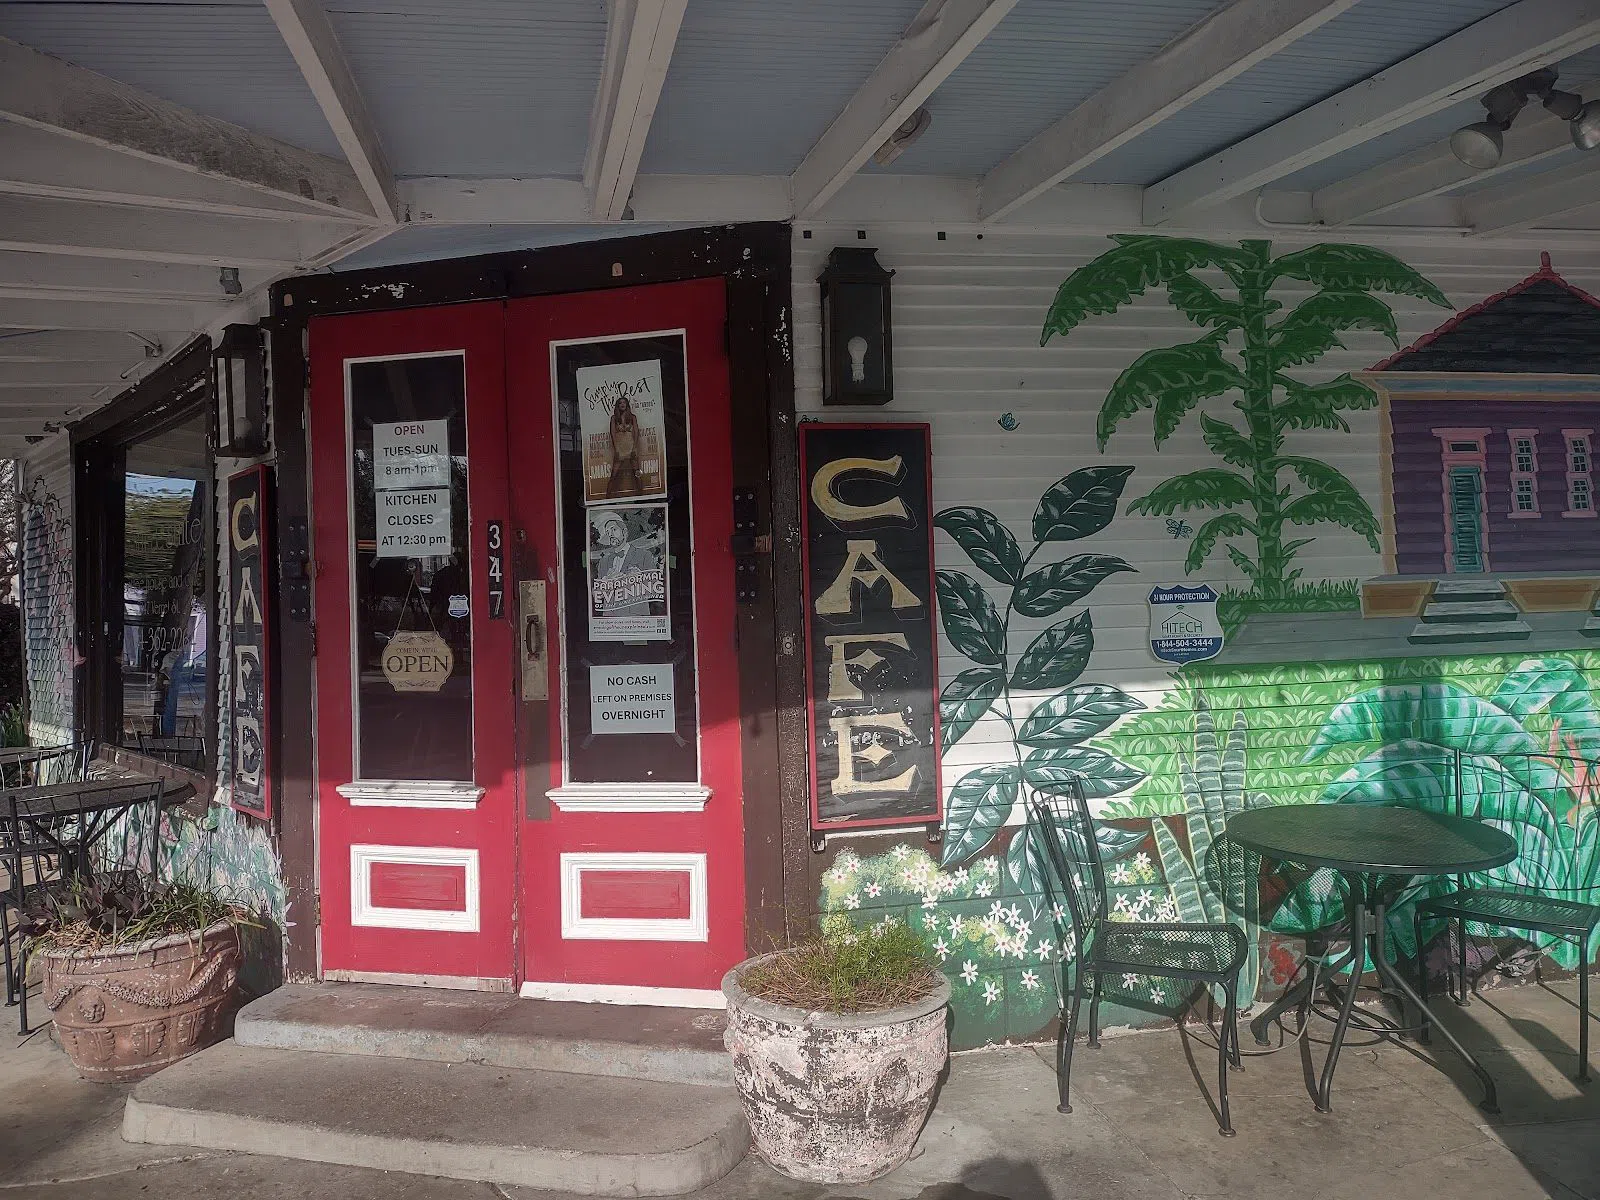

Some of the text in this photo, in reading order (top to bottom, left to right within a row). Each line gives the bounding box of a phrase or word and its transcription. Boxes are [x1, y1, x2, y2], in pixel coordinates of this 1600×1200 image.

[394, 424, 425, 436] OPEN
[383, 443, 439, 457] TUES-SUN
[385, 465, 392, 475] 8
[385, 493, 437, 506] KITCHEN
[387, 514, 434, 526] CLOSES
[381, 534, 446, 547] AT 12:30 pm
[489, 524, 503, 615] 347
[593, 572, 664, 590] PARANORMAL
[593, 580, 665, 604] EVENING
[1174, 592, 1210, 601] PROTECTION
[811, 454, 923, 796] CAFE
[1161, 621, 1203, 634] HITECH
[232, 490, 262, 785] CAFE
[1156, 638, 1213, 648] 1-844-504-3444
[386, 655, 449, 673] OPEN
[607, 675, 657, 687] NO CASH
[592, 692, 672, 704] LEFT ON PREMISES
[601, 709, 666, 721] OVERNIGHT
